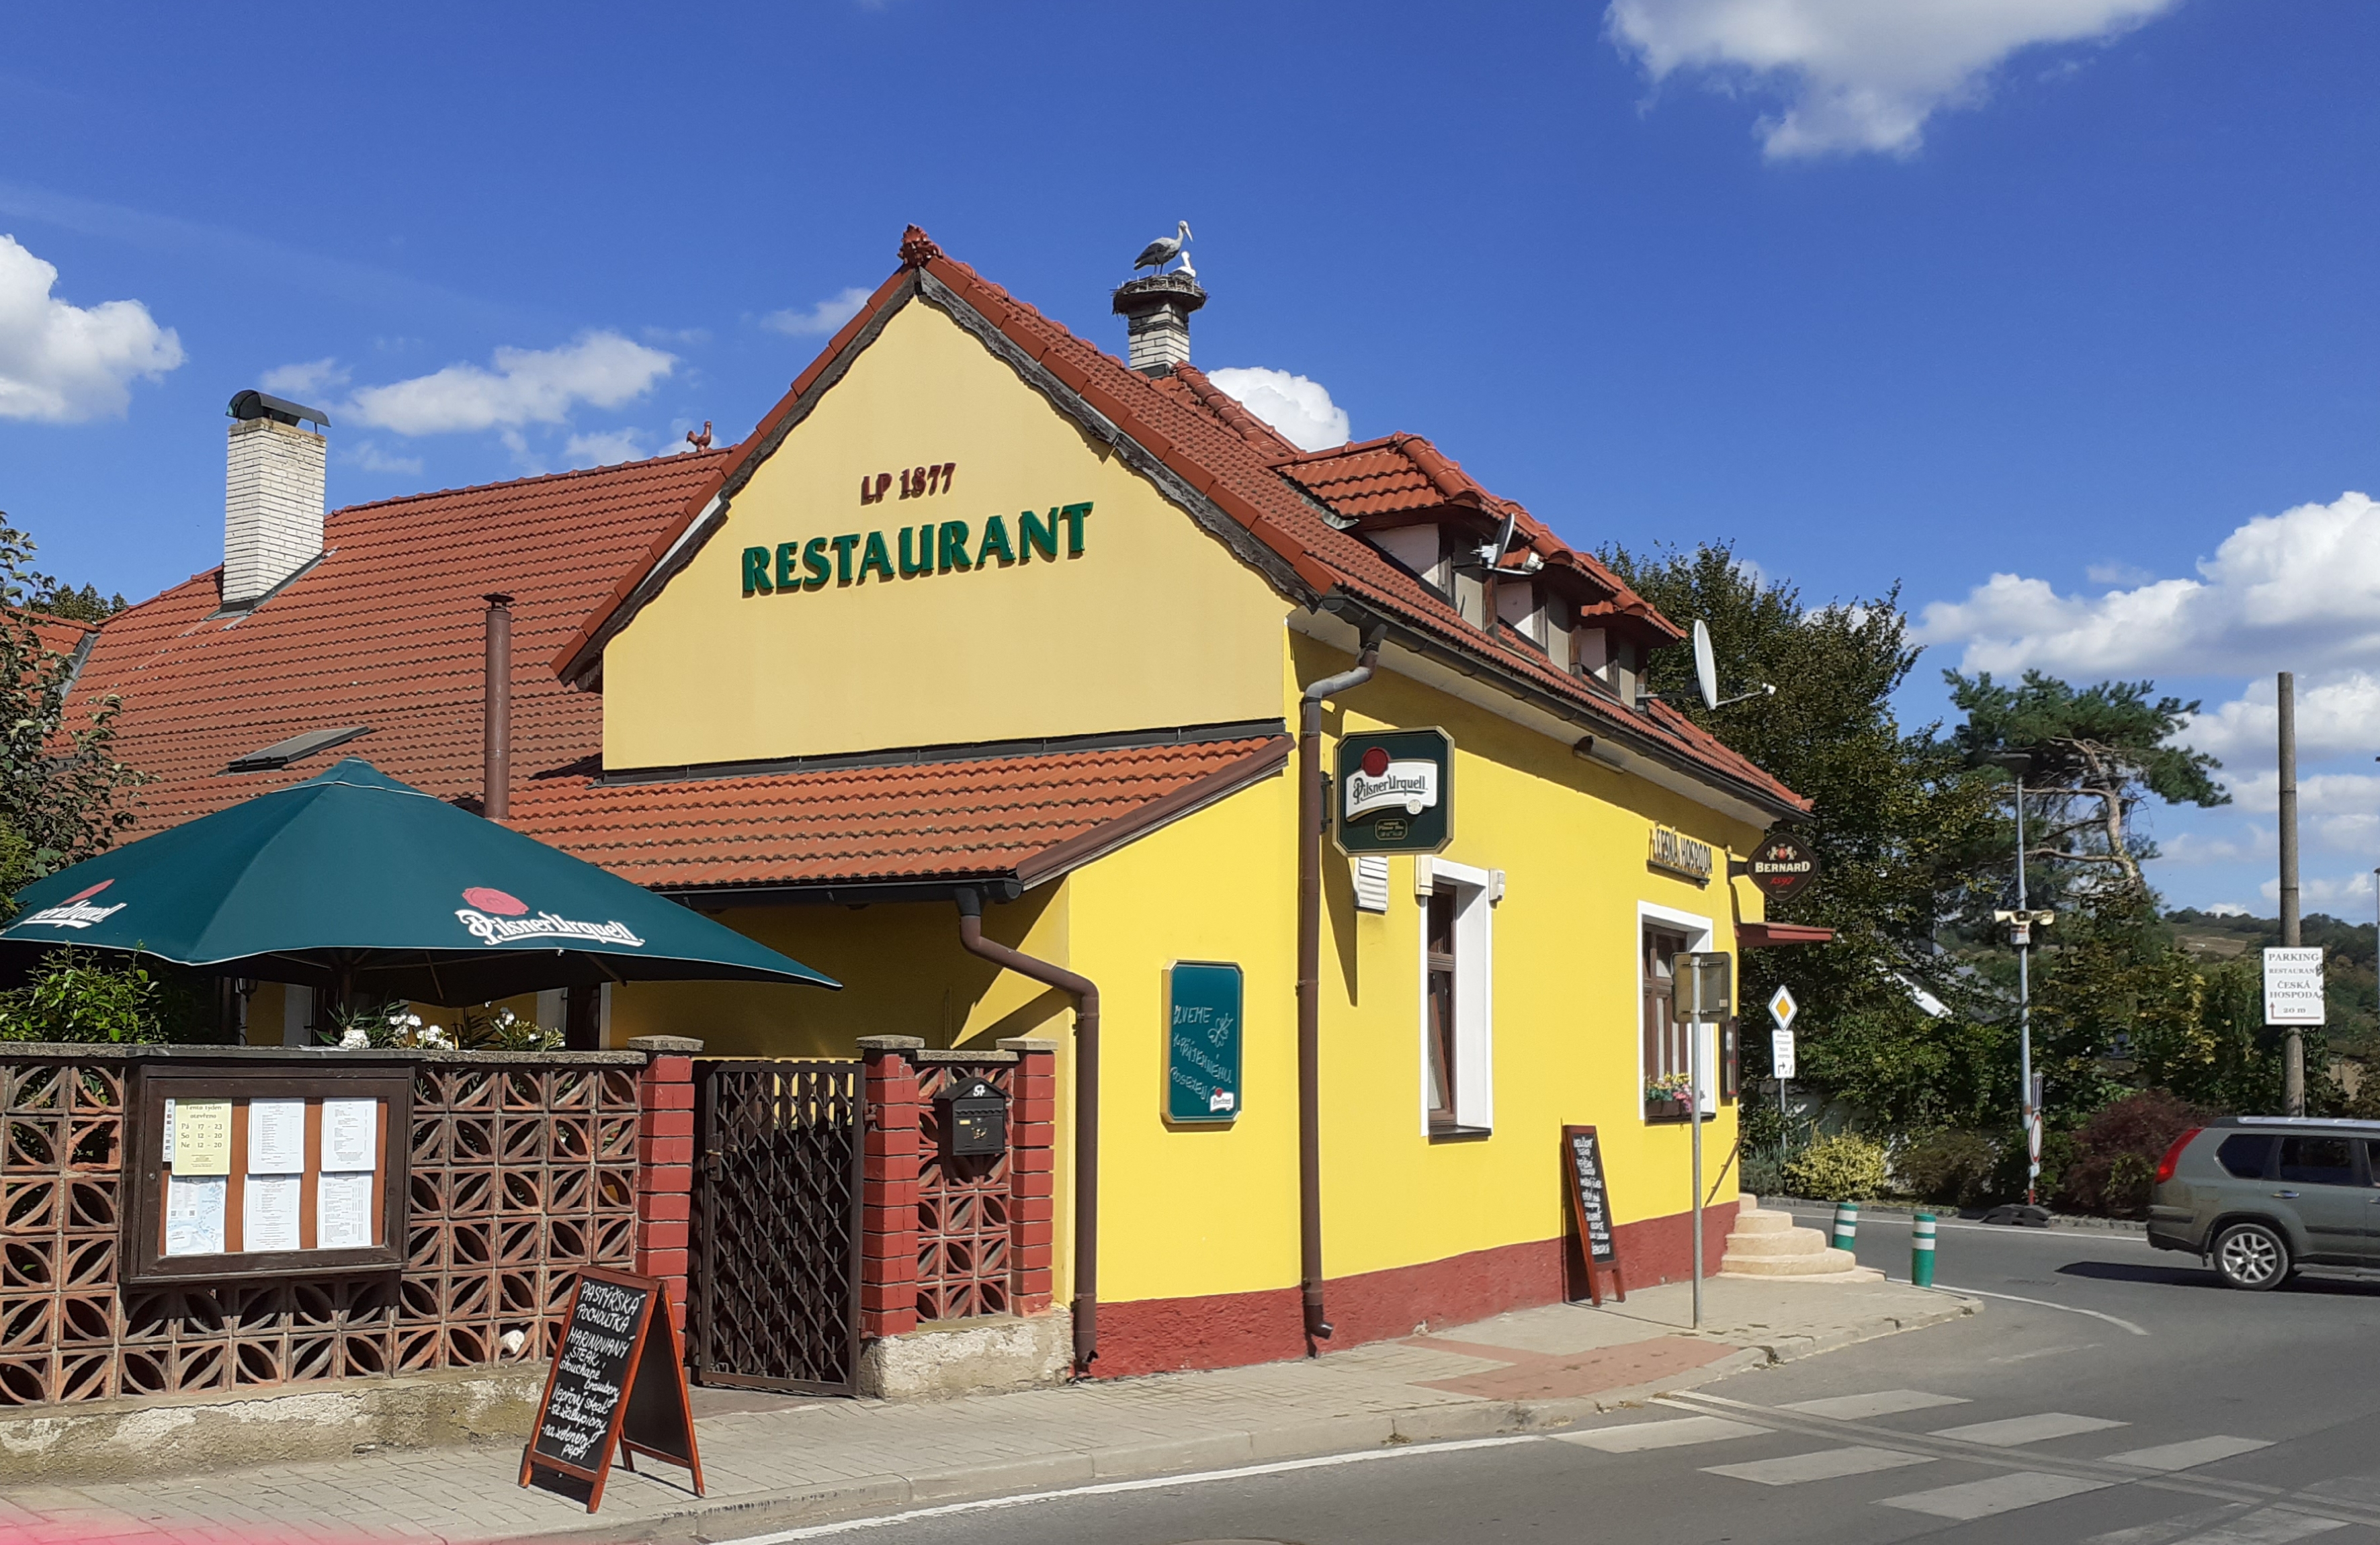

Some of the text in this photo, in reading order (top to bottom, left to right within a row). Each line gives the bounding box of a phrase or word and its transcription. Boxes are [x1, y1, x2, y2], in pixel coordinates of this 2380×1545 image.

[861, 463, 956, 504] LP 1877
[742, 501, 1094, 595] RESTAURANT
[1353, 774, 1426, 805] Pilsner Urquell
[1754, 860, 1811, 873] BERNARD
[454, 910, 639, 945] Pilsner Urquell
[2268, 953, 2319, 961] PARKING
[2277, 980, 2311, 989] ČESKÁ
[580, 1282, 646, 1316] PASTÝŘSKÁ
[577, 1303, 630, 1333] POCHOUTKA
[567, 1326, 636, 1359] MARINOVANÝ
[570, 1346, 600, 1366] STEAK
[552, 1382, 608, 1414] Vepřový steak
